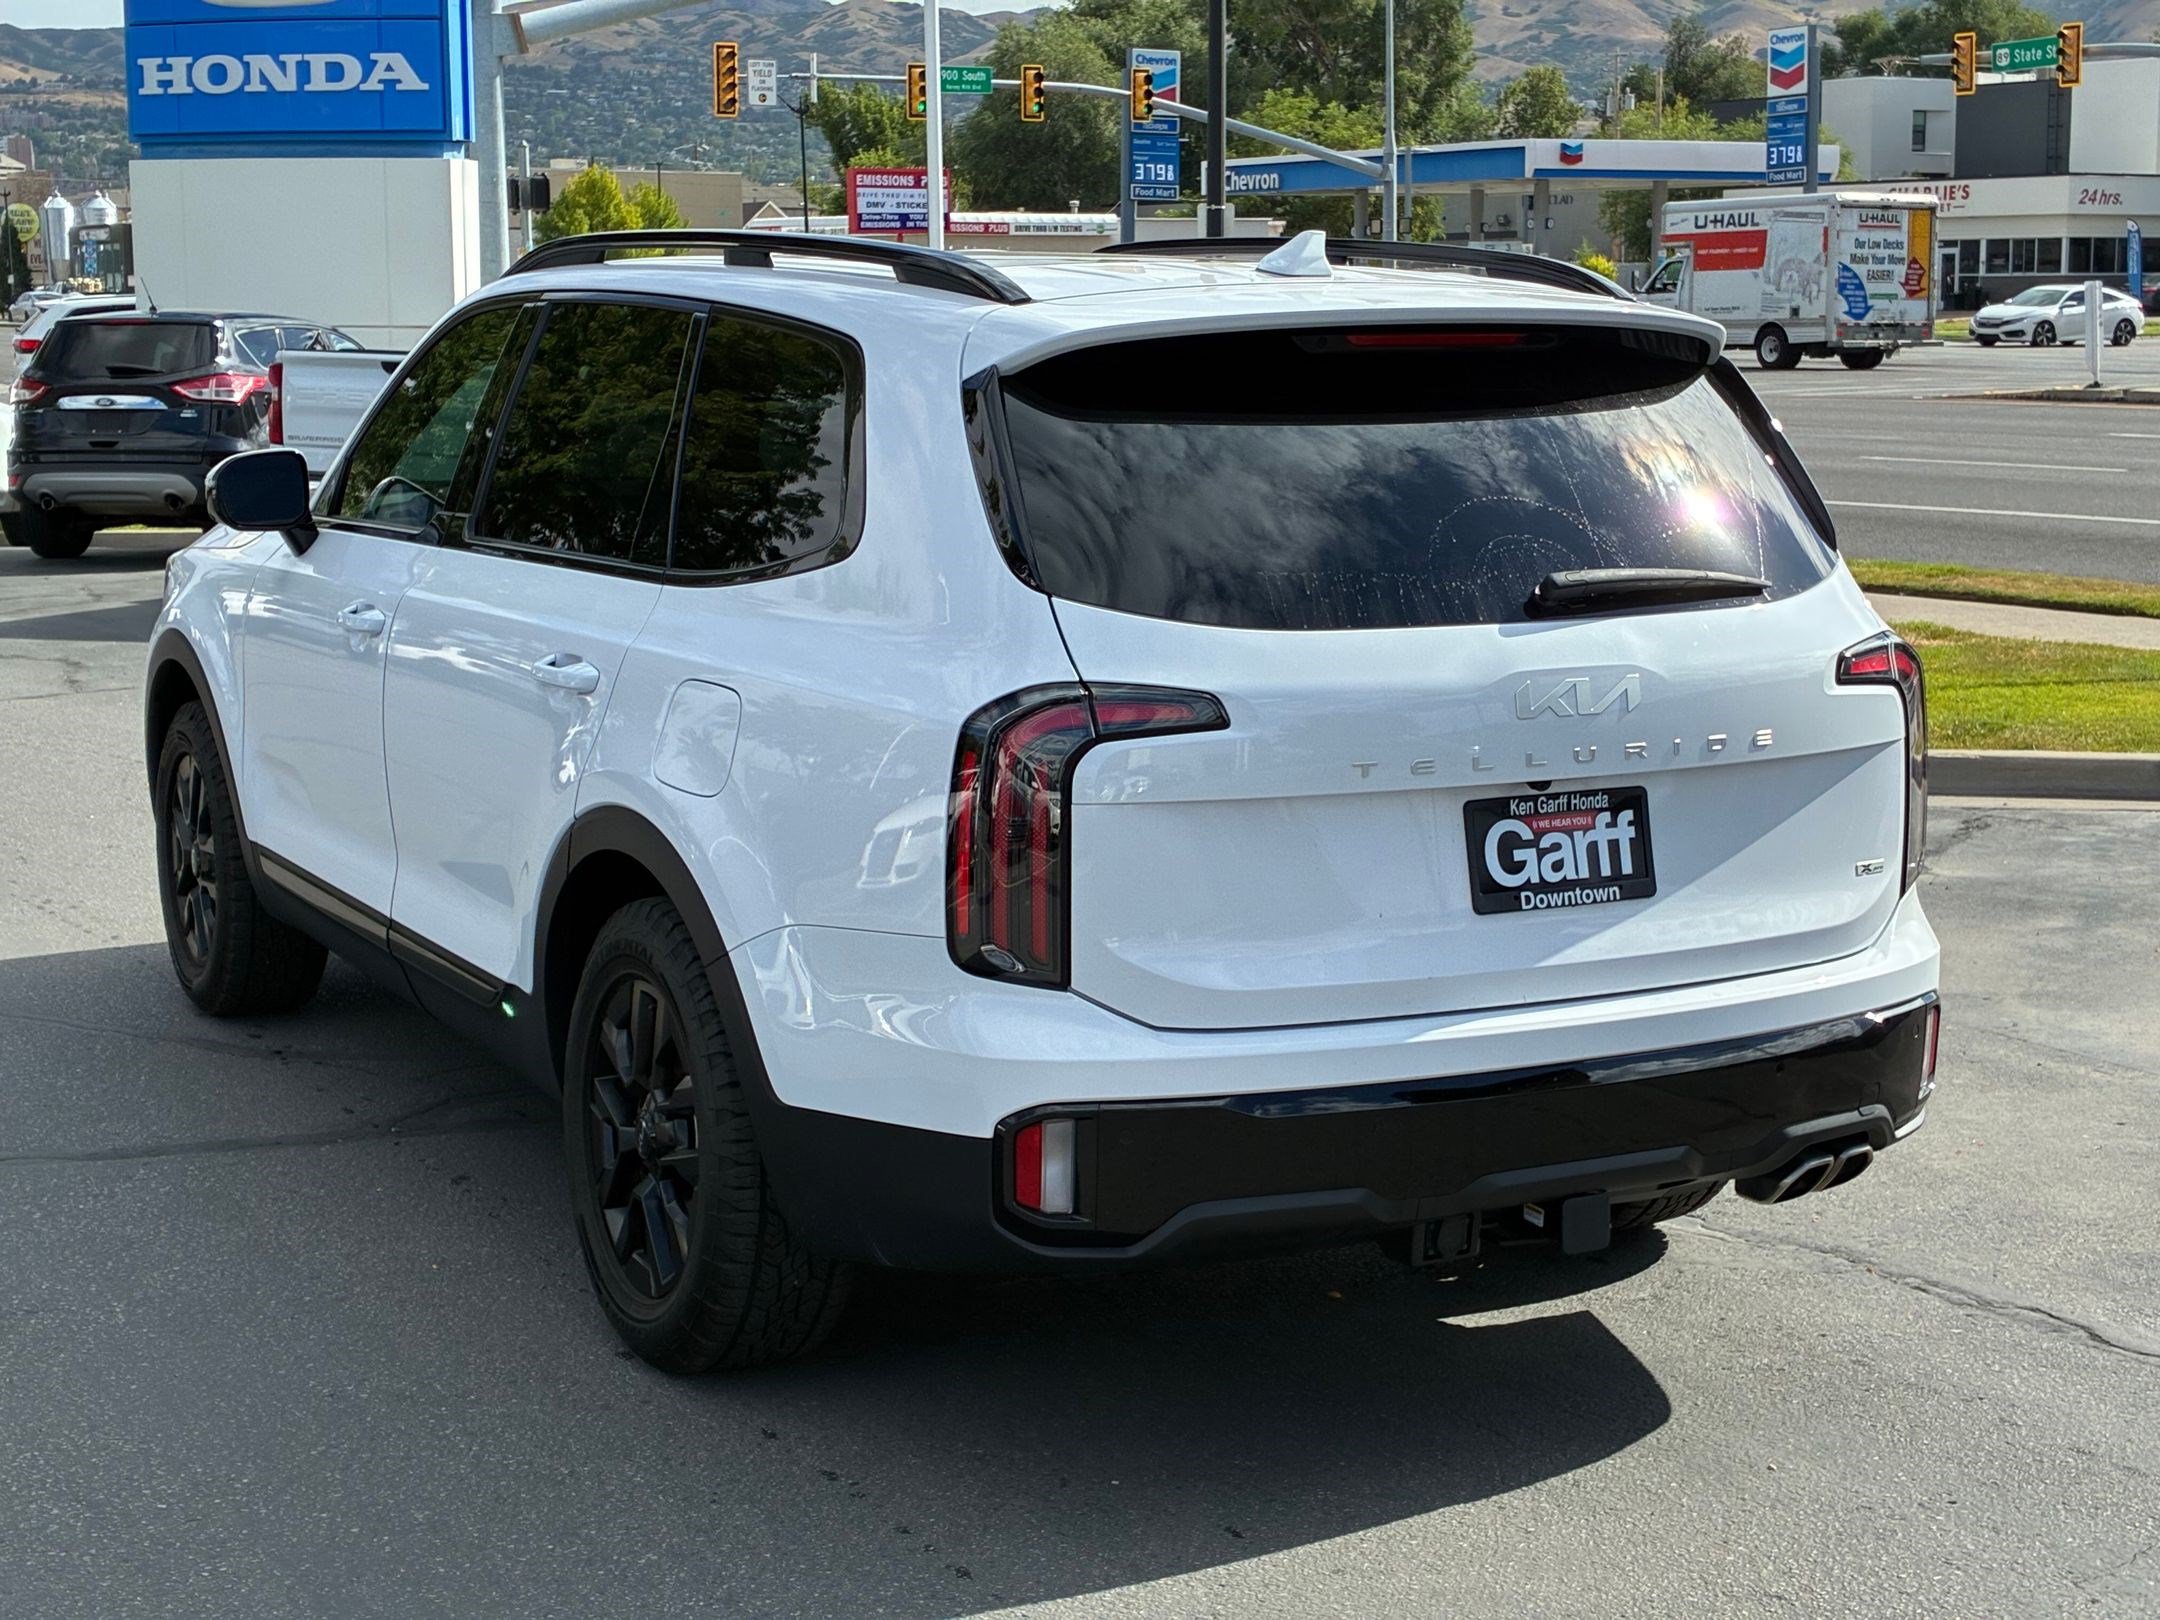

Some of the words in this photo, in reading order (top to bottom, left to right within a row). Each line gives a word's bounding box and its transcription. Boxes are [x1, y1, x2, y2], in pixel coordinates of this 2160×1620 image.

[1770, 33, 1805, 45] Chevron
[1135, 54, 1177, 66] Chevron
[1997, 53, 2009, 64] 89
[2014, 48, 2042, 63] State
[2045, 44, 2057, 59] St
[137, 52, 430, 95] HONDA
[752, 69, 773, 78] YIELD
[941, 70, 959, 80] 900
[962, 70, 986, 81] South
[856, 174, 914, 186] EMISSIONS
[1224, 171, 1279, 191] Chevron
[1769, 172, 1785, 182] Food
[1786, 170, 1802, 180] Mart
[1135, 188, 1154, 196] Food
[1156, 189, 1175, 197] Mart
[2079, 189, 2098, 205] 24
[2099, 190, 2123, 206] hrs.
[1694, 212, 1761, 229] U-HAUL
[1859, 212, 1900, 224] U-HAUL
[988, 223, 1009, 232] PLUS
[1854, 238, 1866, 249] Our
[1867, 239, 1882, 250] Low
[1883, 239, 1904, 250] Decks
[1850, 253, 1870, 265] Make
[1871, 254, 1886, 265] Your
[1887, 255, 1906, 266] Move
[1867, 269, 1895, 281] EASIER!
[1514, 672, 1640, 720] KIA
[1352, 728, 1774, 778] TELLURIDE
[1510, 798, 1534, 816] Ken
[1537, 793, 1569, 814] Garff
[1571, 791, 1609, 812] Honda
[1538, 820, 1551, 828] WE
[1551, 818, 1572, 828] HEAR
[1572, 816, 1587, 826] YOU
[1484, 809, 1637, 888] Garff
[1520, 885, 1620, 910] Downtown
